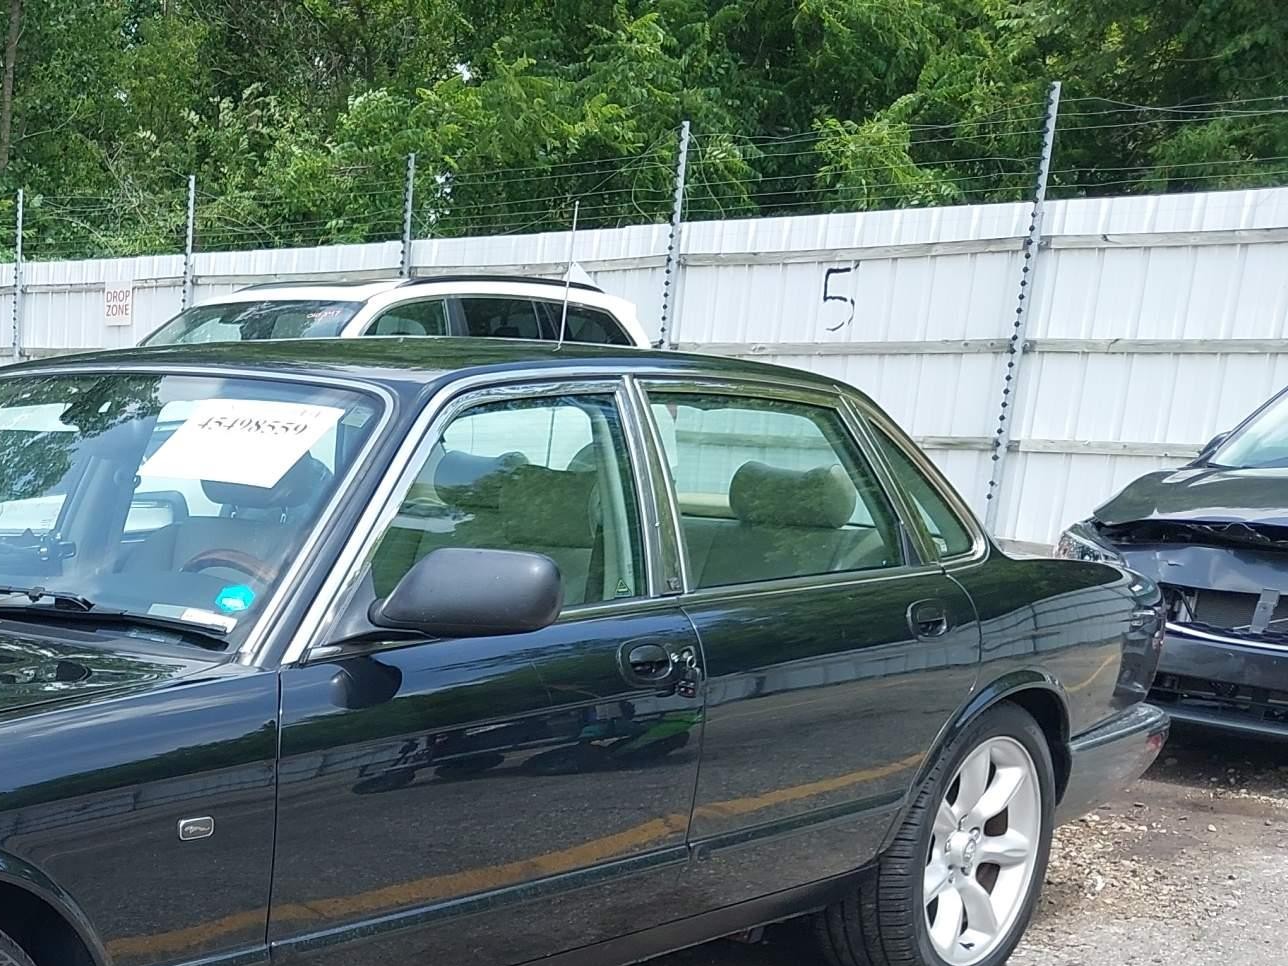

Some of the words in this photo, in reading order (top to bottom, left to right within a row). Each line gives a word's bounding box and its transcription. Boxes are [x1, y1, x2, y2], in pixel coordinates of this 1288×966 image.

[106, 290, 130, 303] DROP
[823, 261, 860, 331] 5
[106, 304, 129, 316] ZONE
